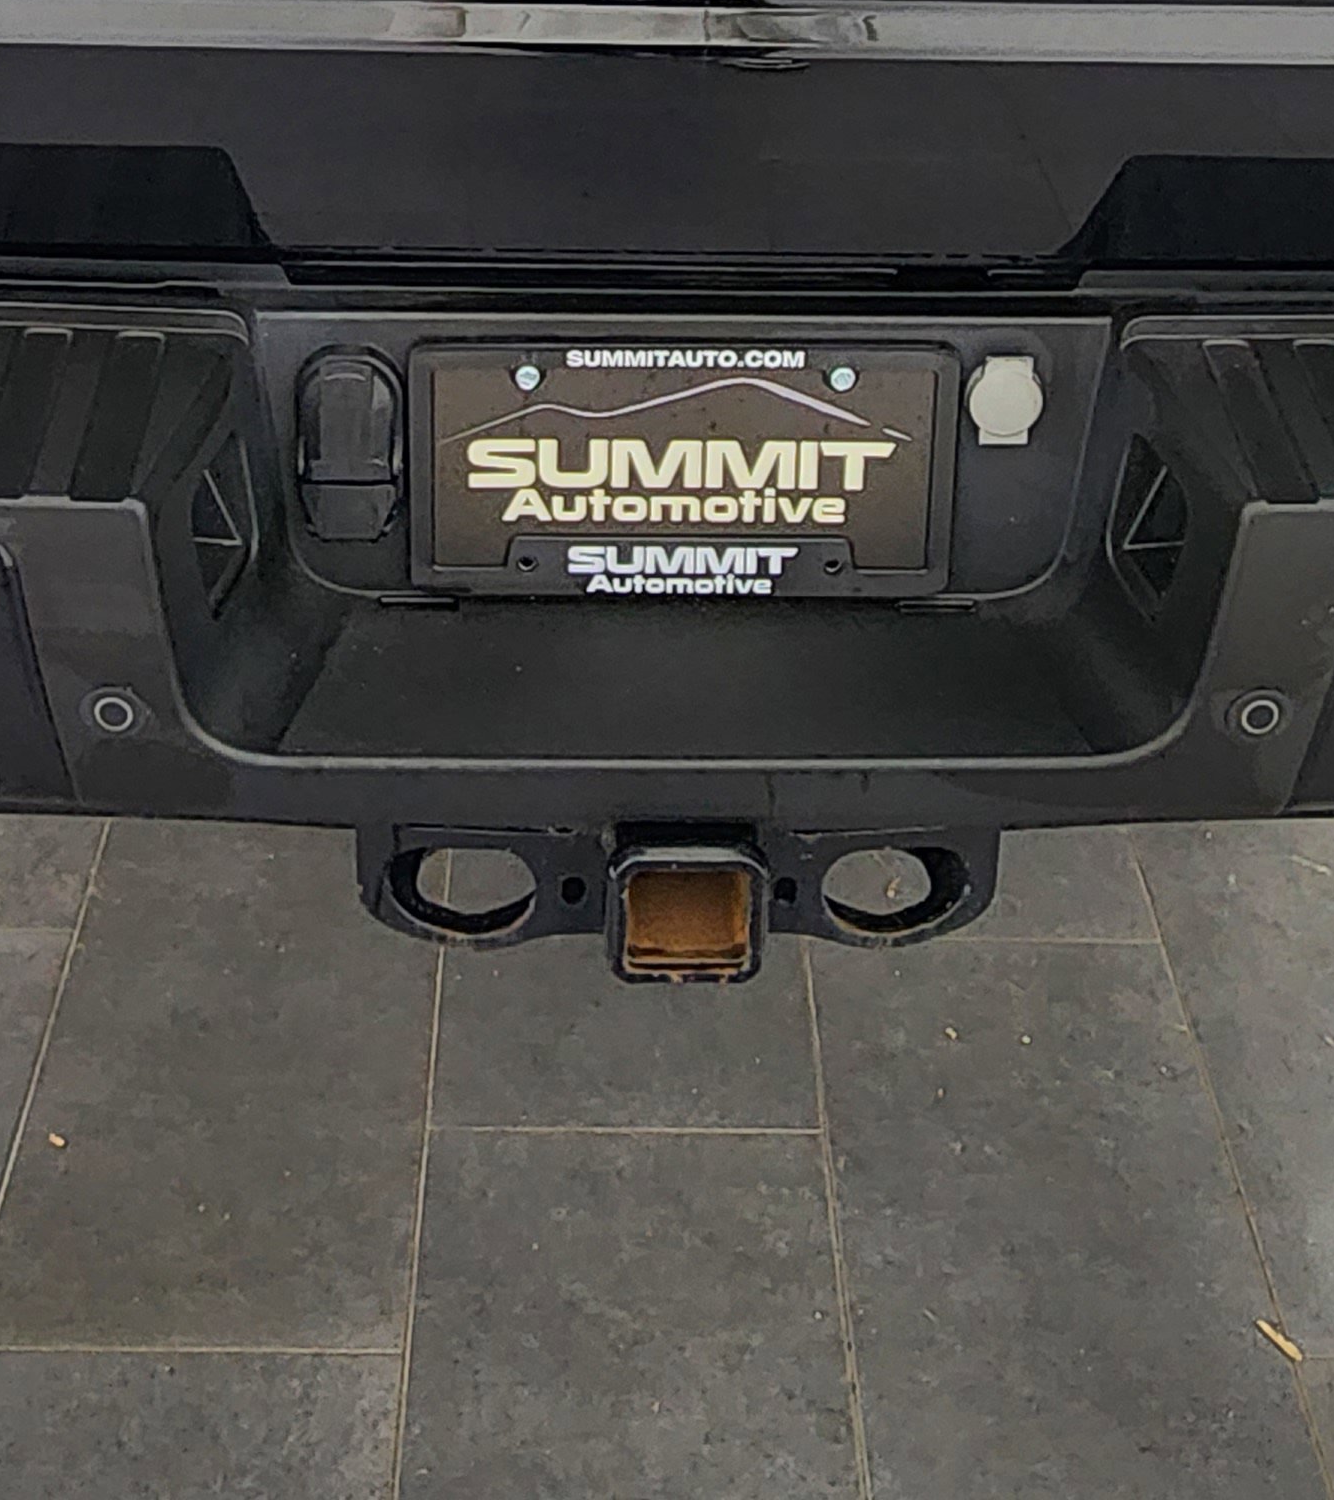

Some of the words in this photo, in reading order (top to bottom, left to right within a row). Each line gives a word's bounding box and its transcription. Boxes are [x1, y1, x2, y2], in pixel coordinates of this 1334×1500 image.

[565, 350, 805, 369] SUMMITAUTO.COM
[468, 438, 896, 491] SUMMIT
[503, 488, 846, 524] Automotive
[567, 546, 799, 576] SUMMIT
[586, 574, 773, 596] Automotive
